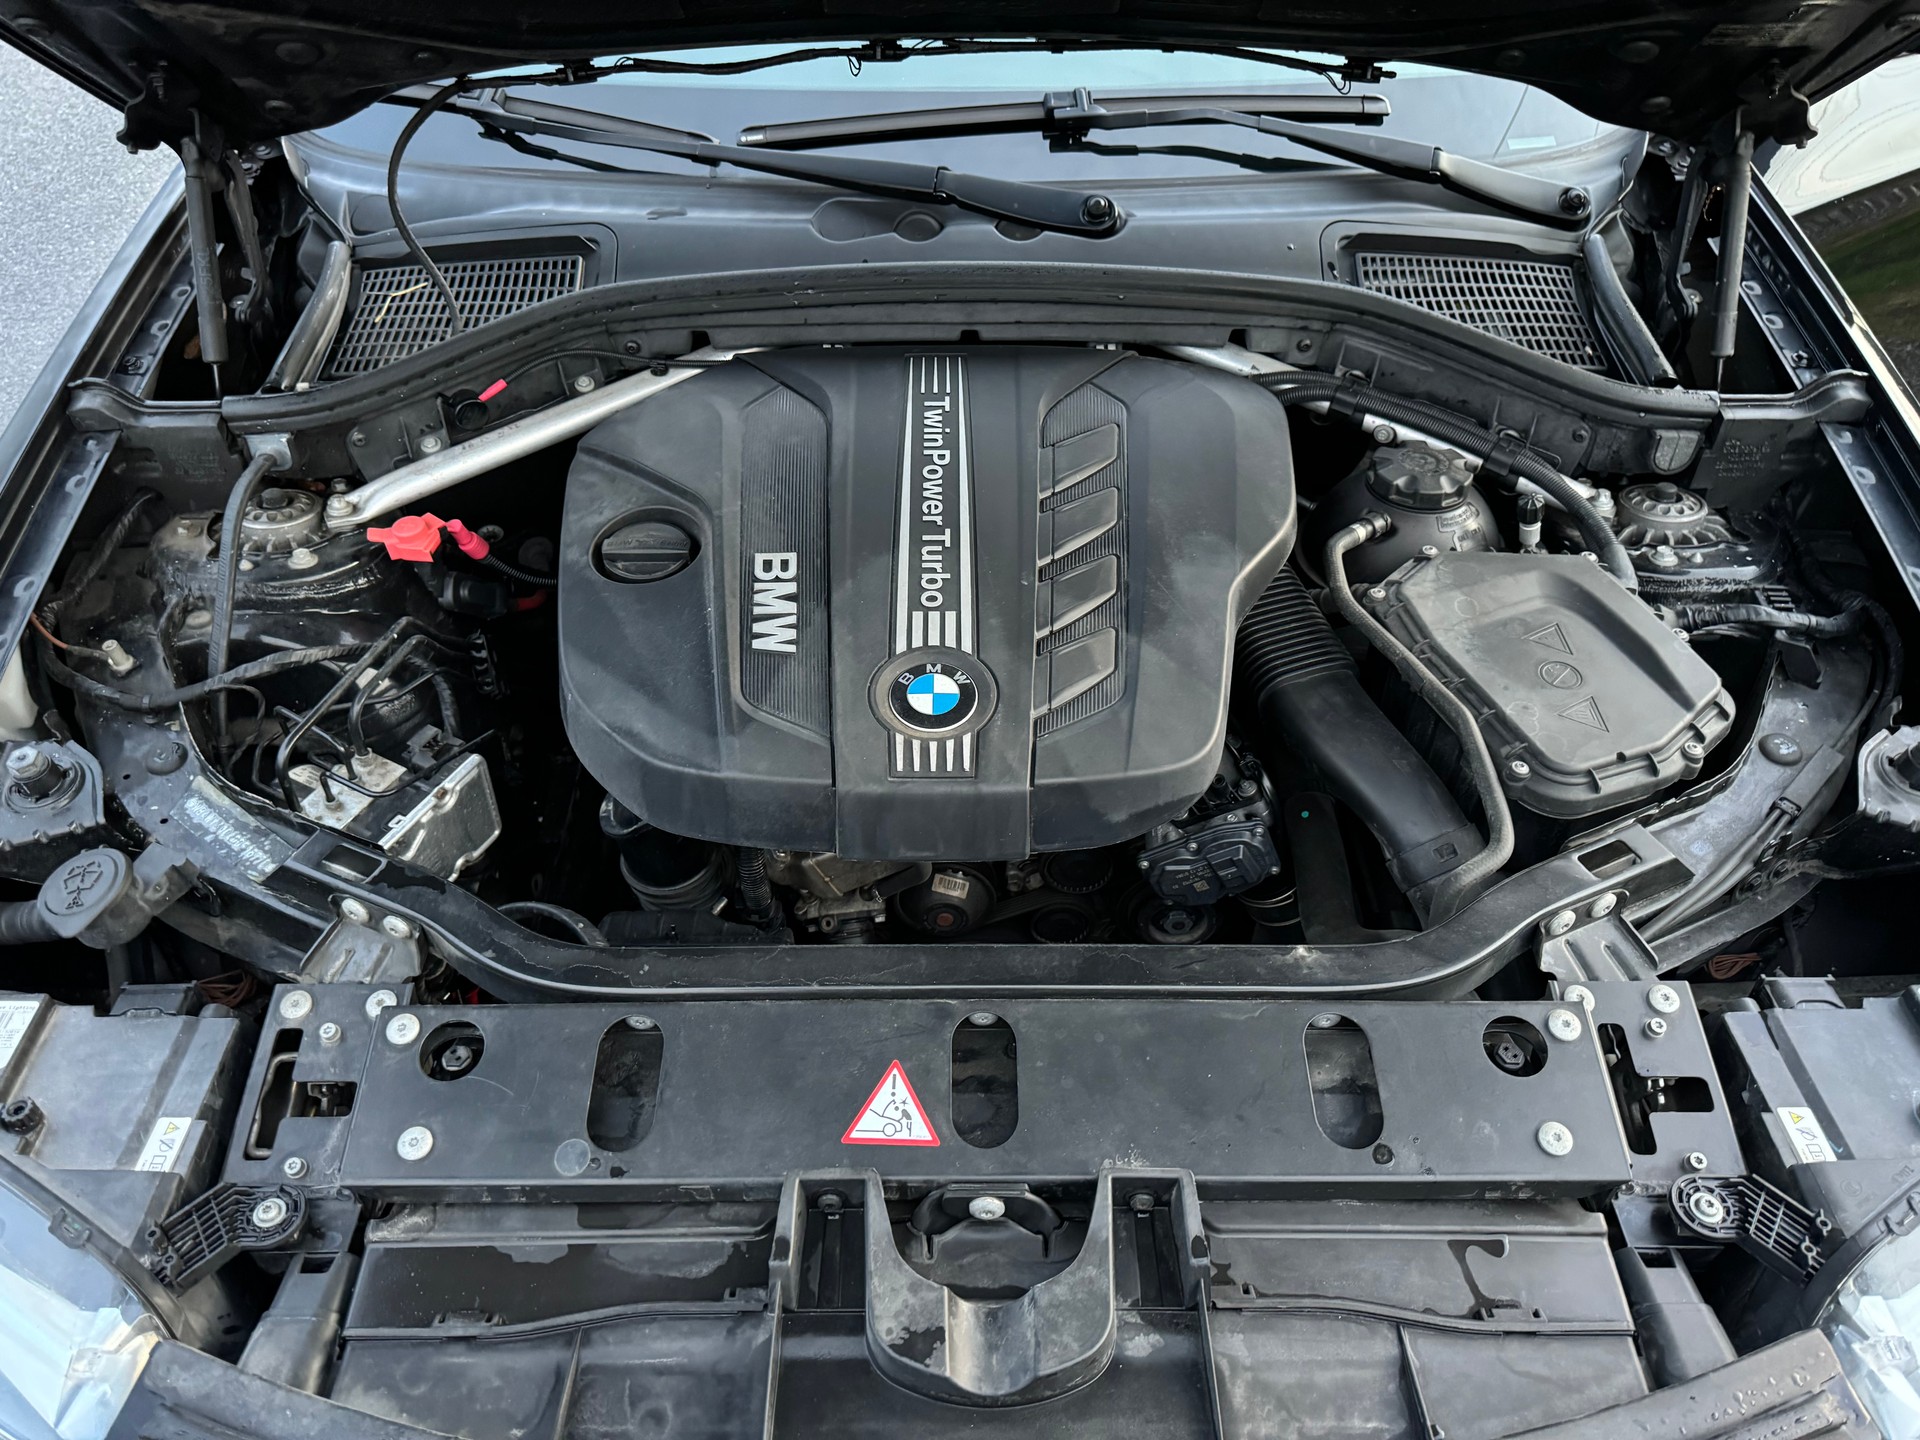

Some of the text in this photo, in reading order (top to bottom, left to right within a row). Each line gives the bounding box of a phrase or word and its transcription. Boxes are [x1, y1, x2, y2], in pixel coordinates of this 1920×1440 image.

[920, 396, 951, 608] TwinPower Turbo
[752, 551, 798, 654] BMW
[898, 663, 971, 686] BMW
